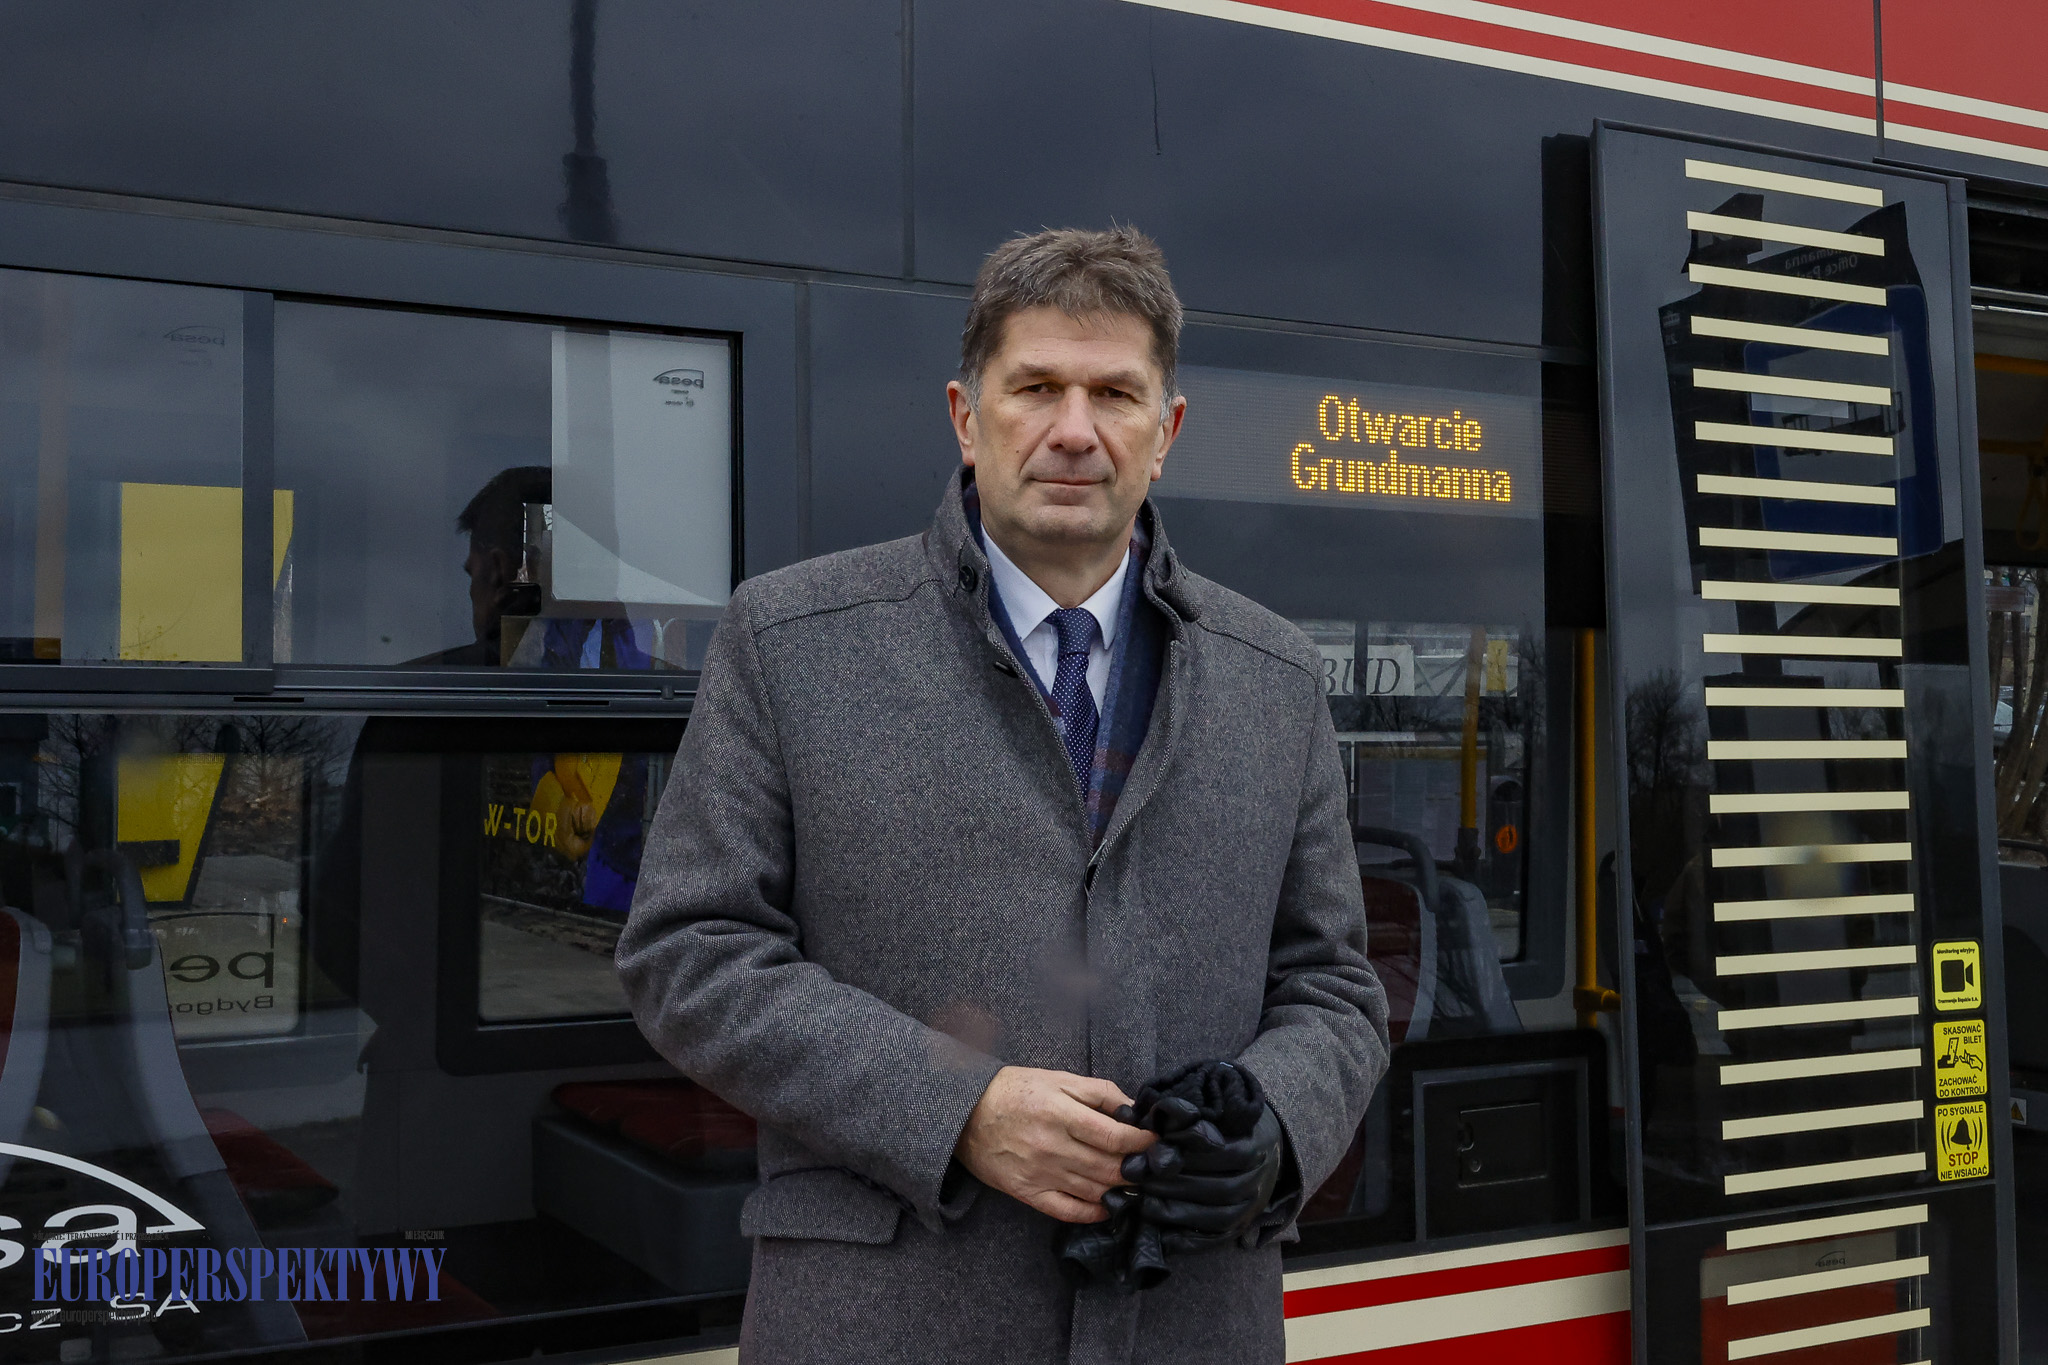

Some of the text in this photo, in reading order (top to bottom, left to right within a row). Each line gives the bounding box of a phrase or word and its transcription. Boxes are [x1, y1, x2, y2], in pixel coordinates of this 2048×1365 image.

[1319, 394, 1482, 452] Otwarcie
[1291, 442, 1512, 502] Grundmanna
[1943, 1023, 1982, 1036] SKASOWAĆ
[1964, 1035, 1982, 1044] BILET
[1939, 1074, 1978, 1087] ZACHOWAĆ
[1940, 1086, 1985, 1098] DO KONTROLI
[1938, 1104, 1984, 1117] PO SYGNALE
[1948, 1151, 1979, 1167] STOP
[1940, 1165, 1988, 1180] NIE WSIADAĆ
[109, 1289, 201, 1320] SA
